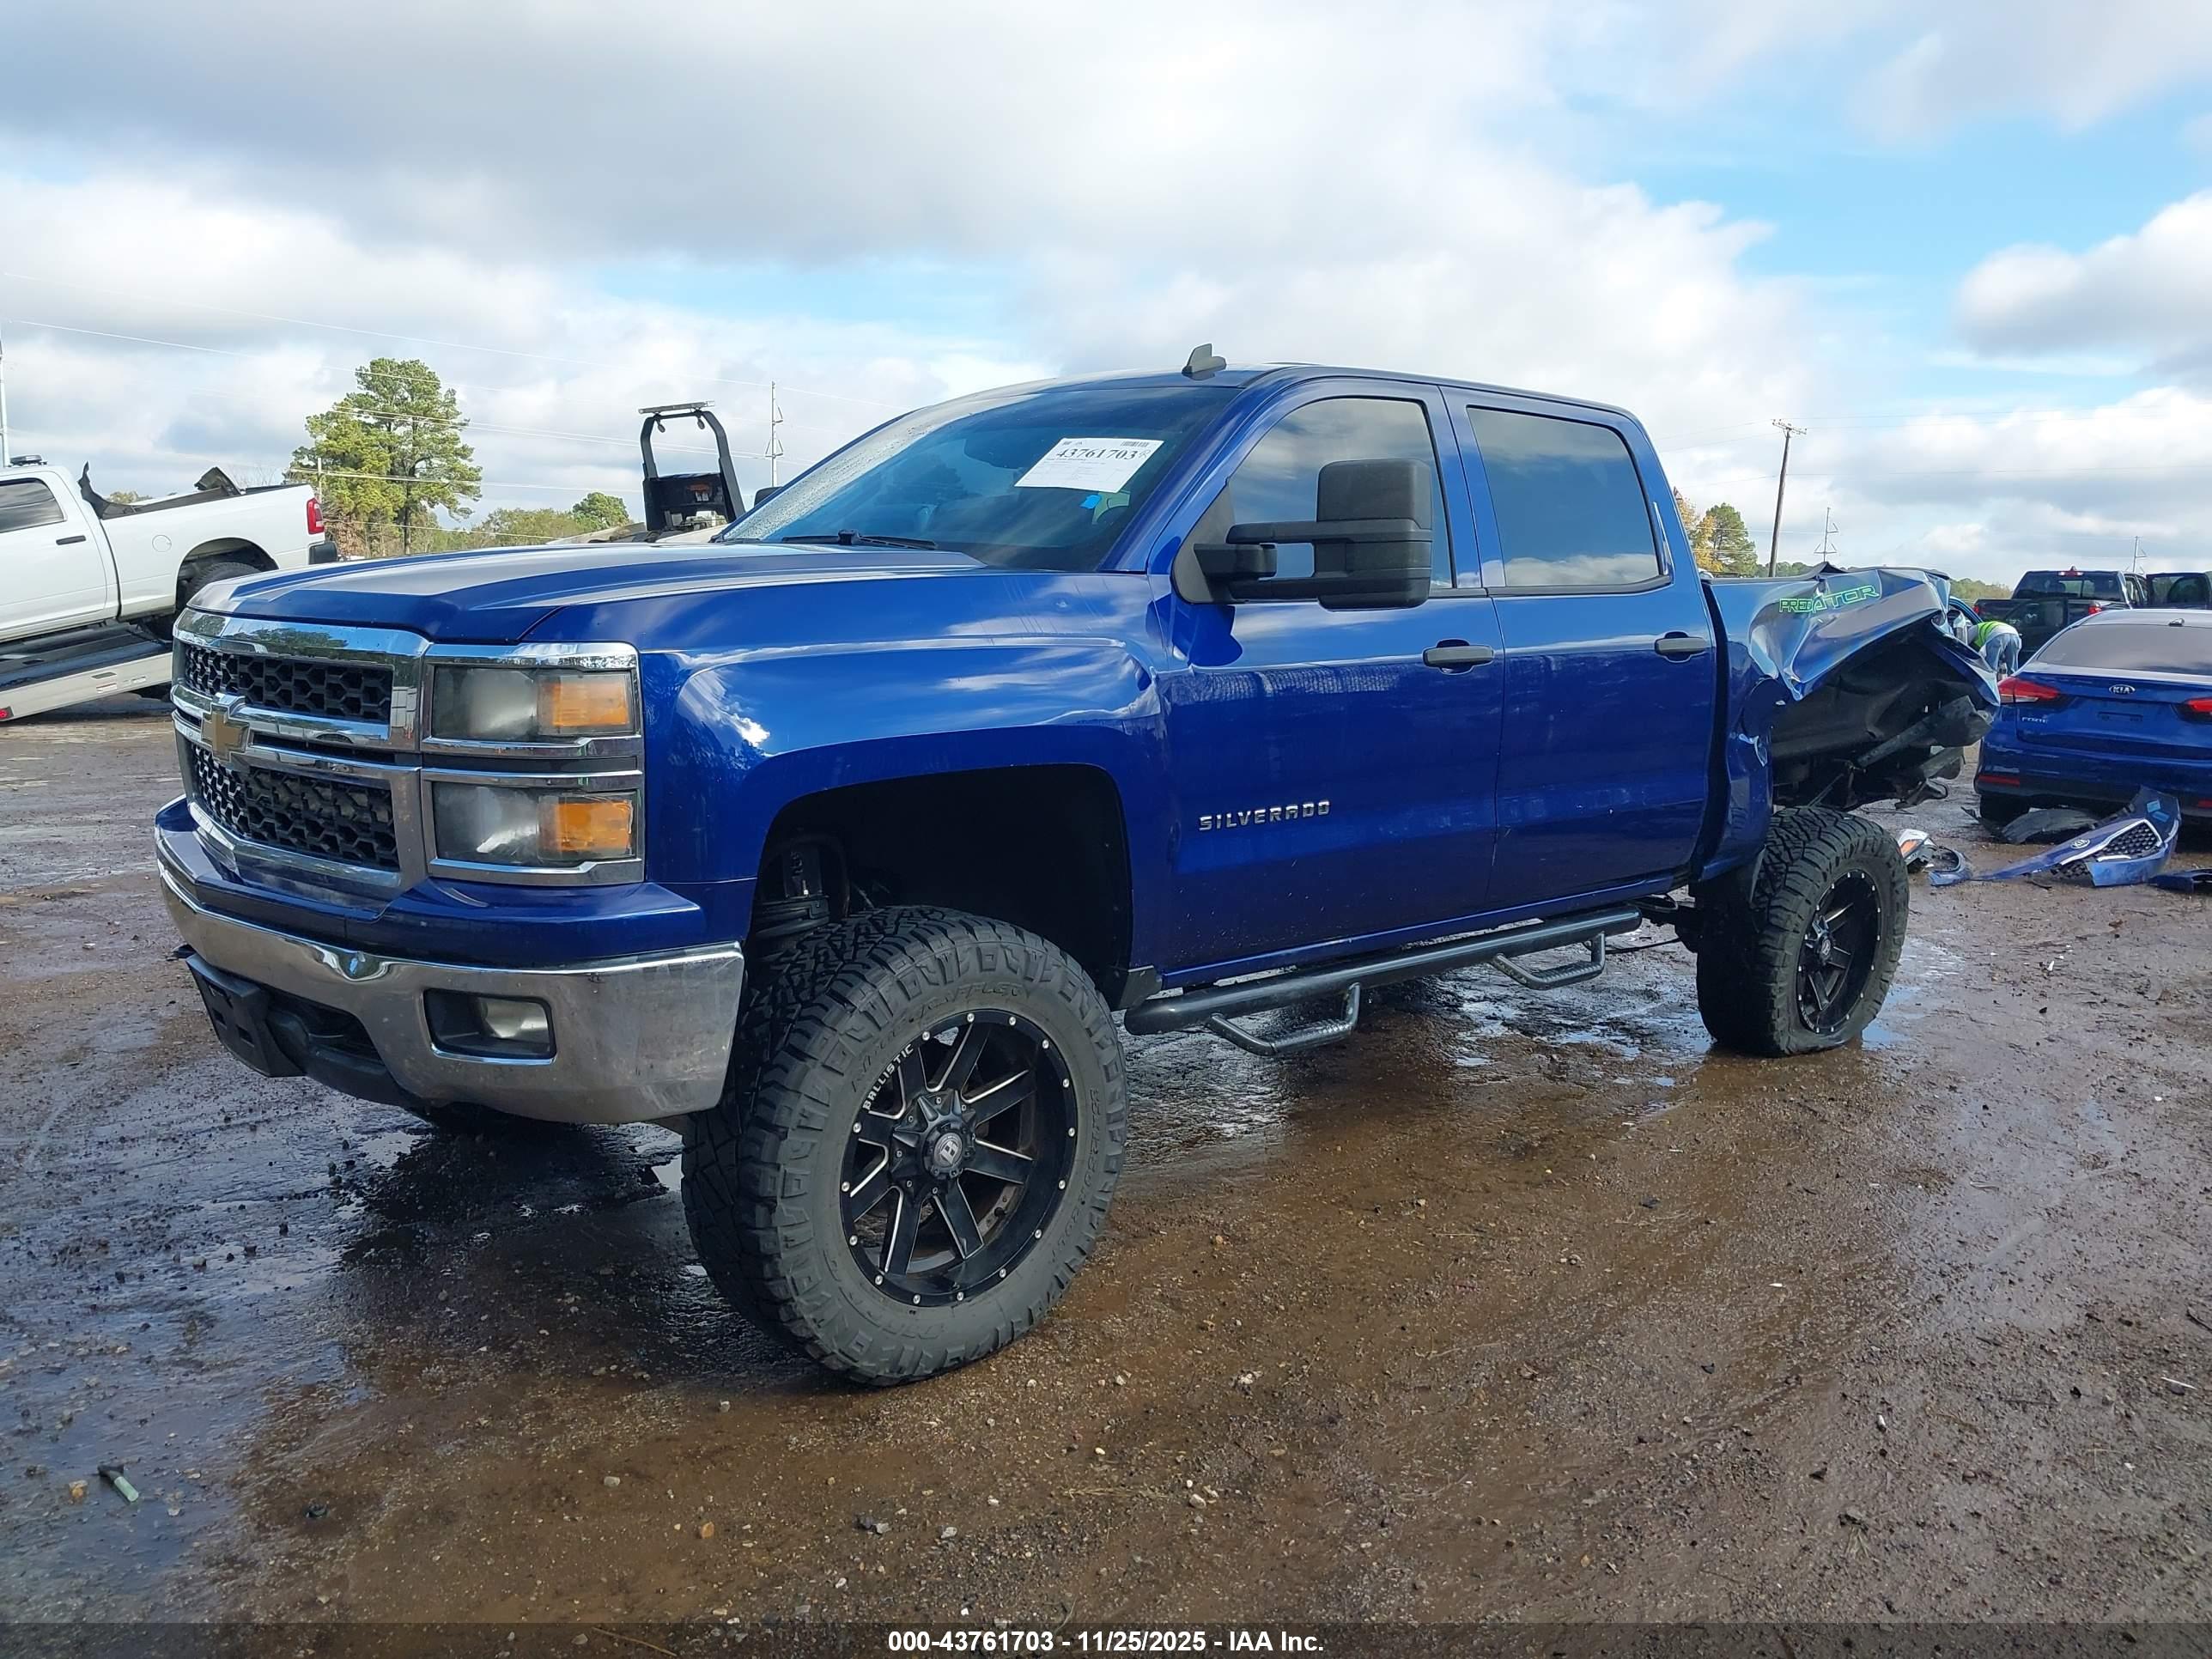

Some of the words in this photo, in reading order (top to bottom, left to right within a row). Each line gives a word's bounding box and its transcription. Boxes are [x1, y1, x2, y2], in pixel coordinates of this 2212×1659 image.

[1056, 448, 1138, 459] 43761703
[1779, 585, 1880, 613] PREDATOR
[1199, 800, 1330, 831] SILVERADO
[862, 1043, 914, 1110] BALLISTIC
